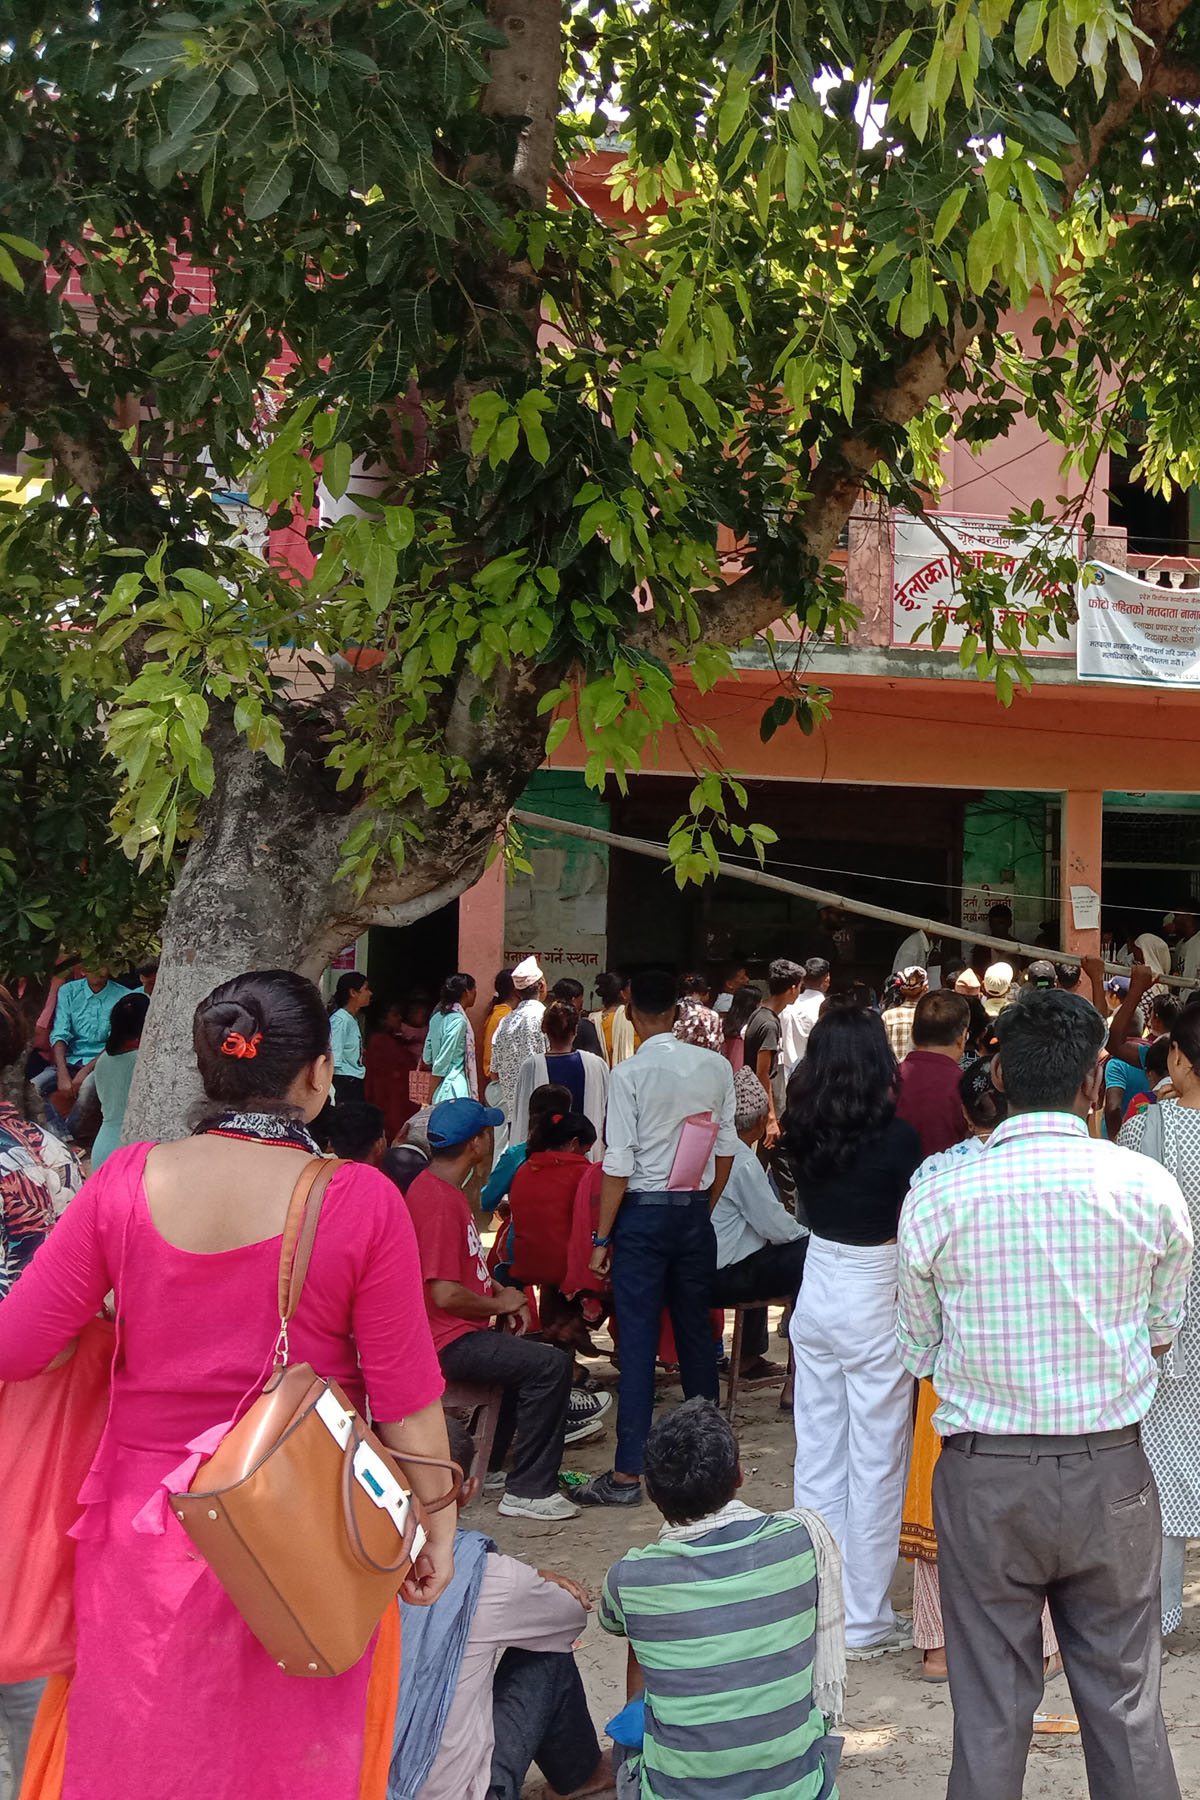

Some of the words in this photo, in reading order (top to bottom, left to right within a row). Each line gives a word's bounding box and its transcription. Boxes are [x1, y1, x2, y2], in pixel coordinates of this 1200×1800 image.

[1088, 597, 1109, 610] फोटो
[1111, 600, 1144, 615] सहितको
[1146, 606, 1178, 619] मतदाता
[544, 948, 564, 964] गर्ने
[566, 951, 599, 967] स्थान
